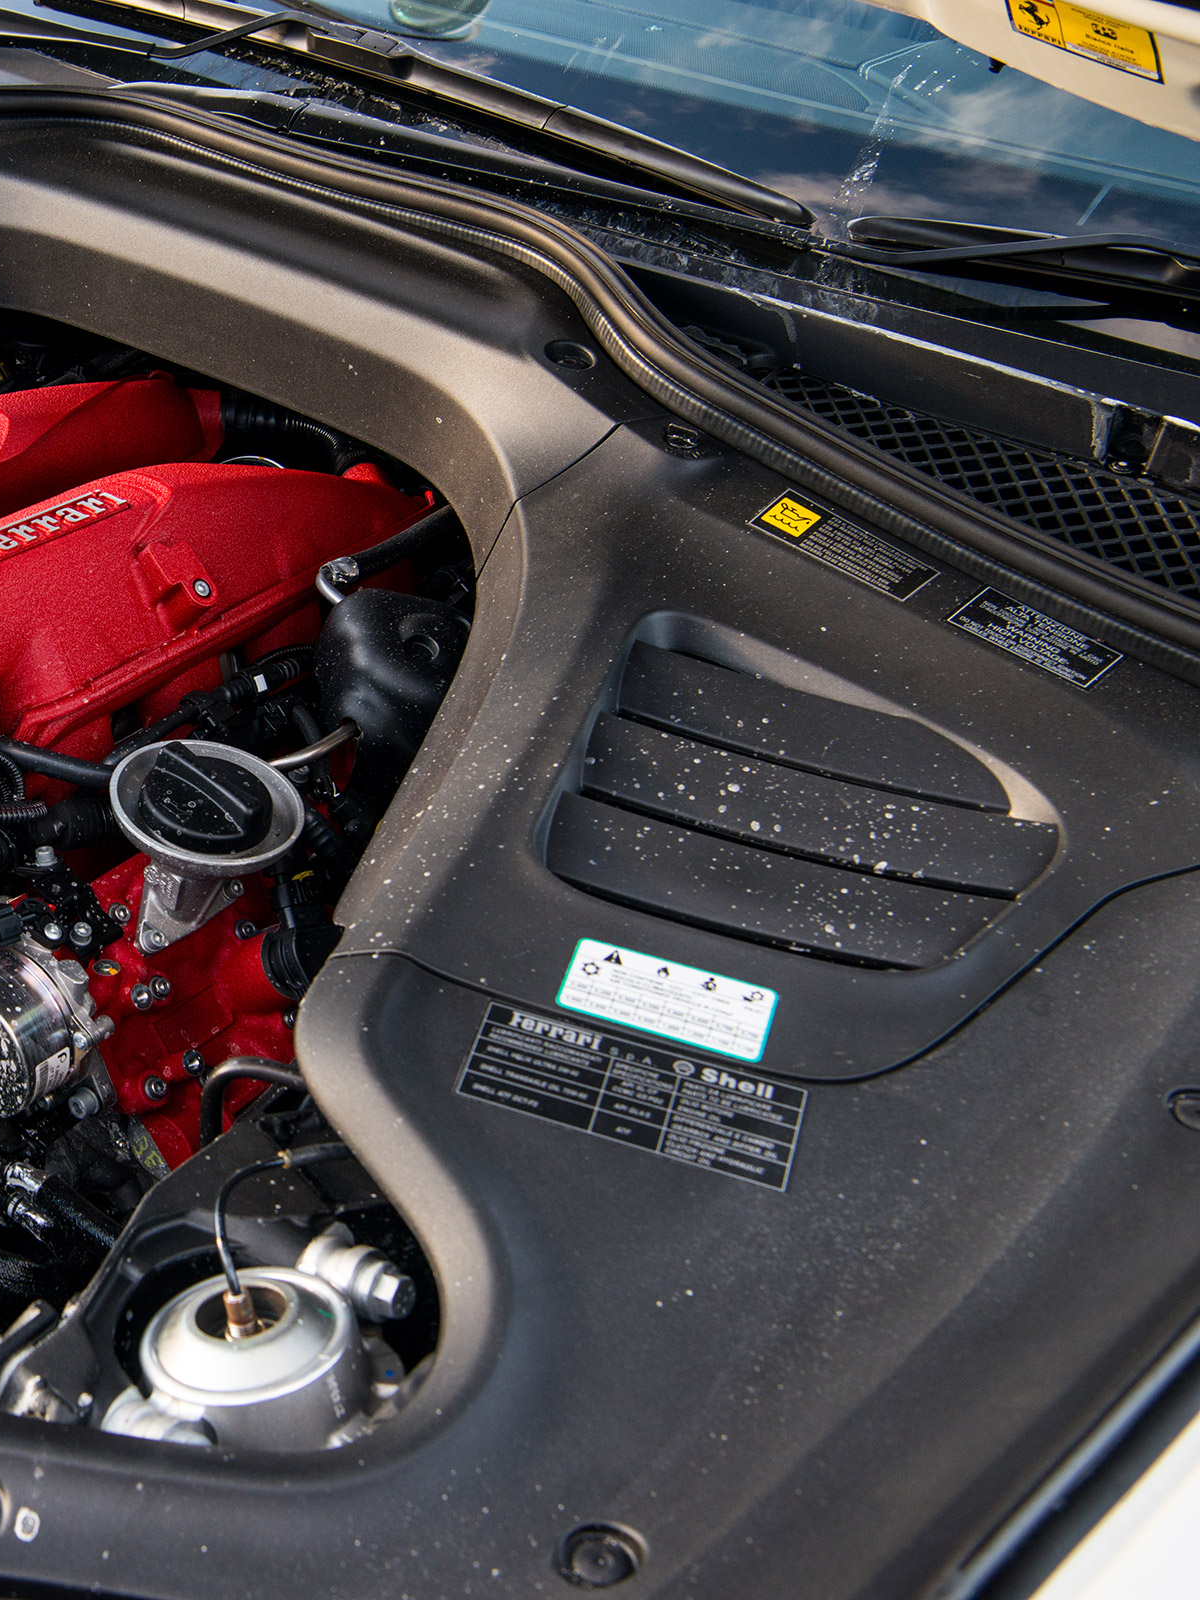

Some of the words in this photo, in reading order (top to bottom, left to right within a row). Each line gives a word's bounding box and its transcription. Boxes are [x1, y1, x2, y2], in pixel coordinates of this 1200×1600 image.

[958, 615, 971, 623] DO
[968, 620, 984, 629] NOT
[1003, 623, 1061, 654] WARNING
[1004, 605, 1032, 620] ALTA
[1031, 618, 1090, 650] TENSIONE
[1015, 604, 1087, 642] ATTENZIONE
[986, 622, 1017, 639] HIGH
[1016, 637, 1068, 664] VOLTAGE
[507, 1011, 603, 1051] Ferrari
[699, 1065, 774, 1099] Shell
